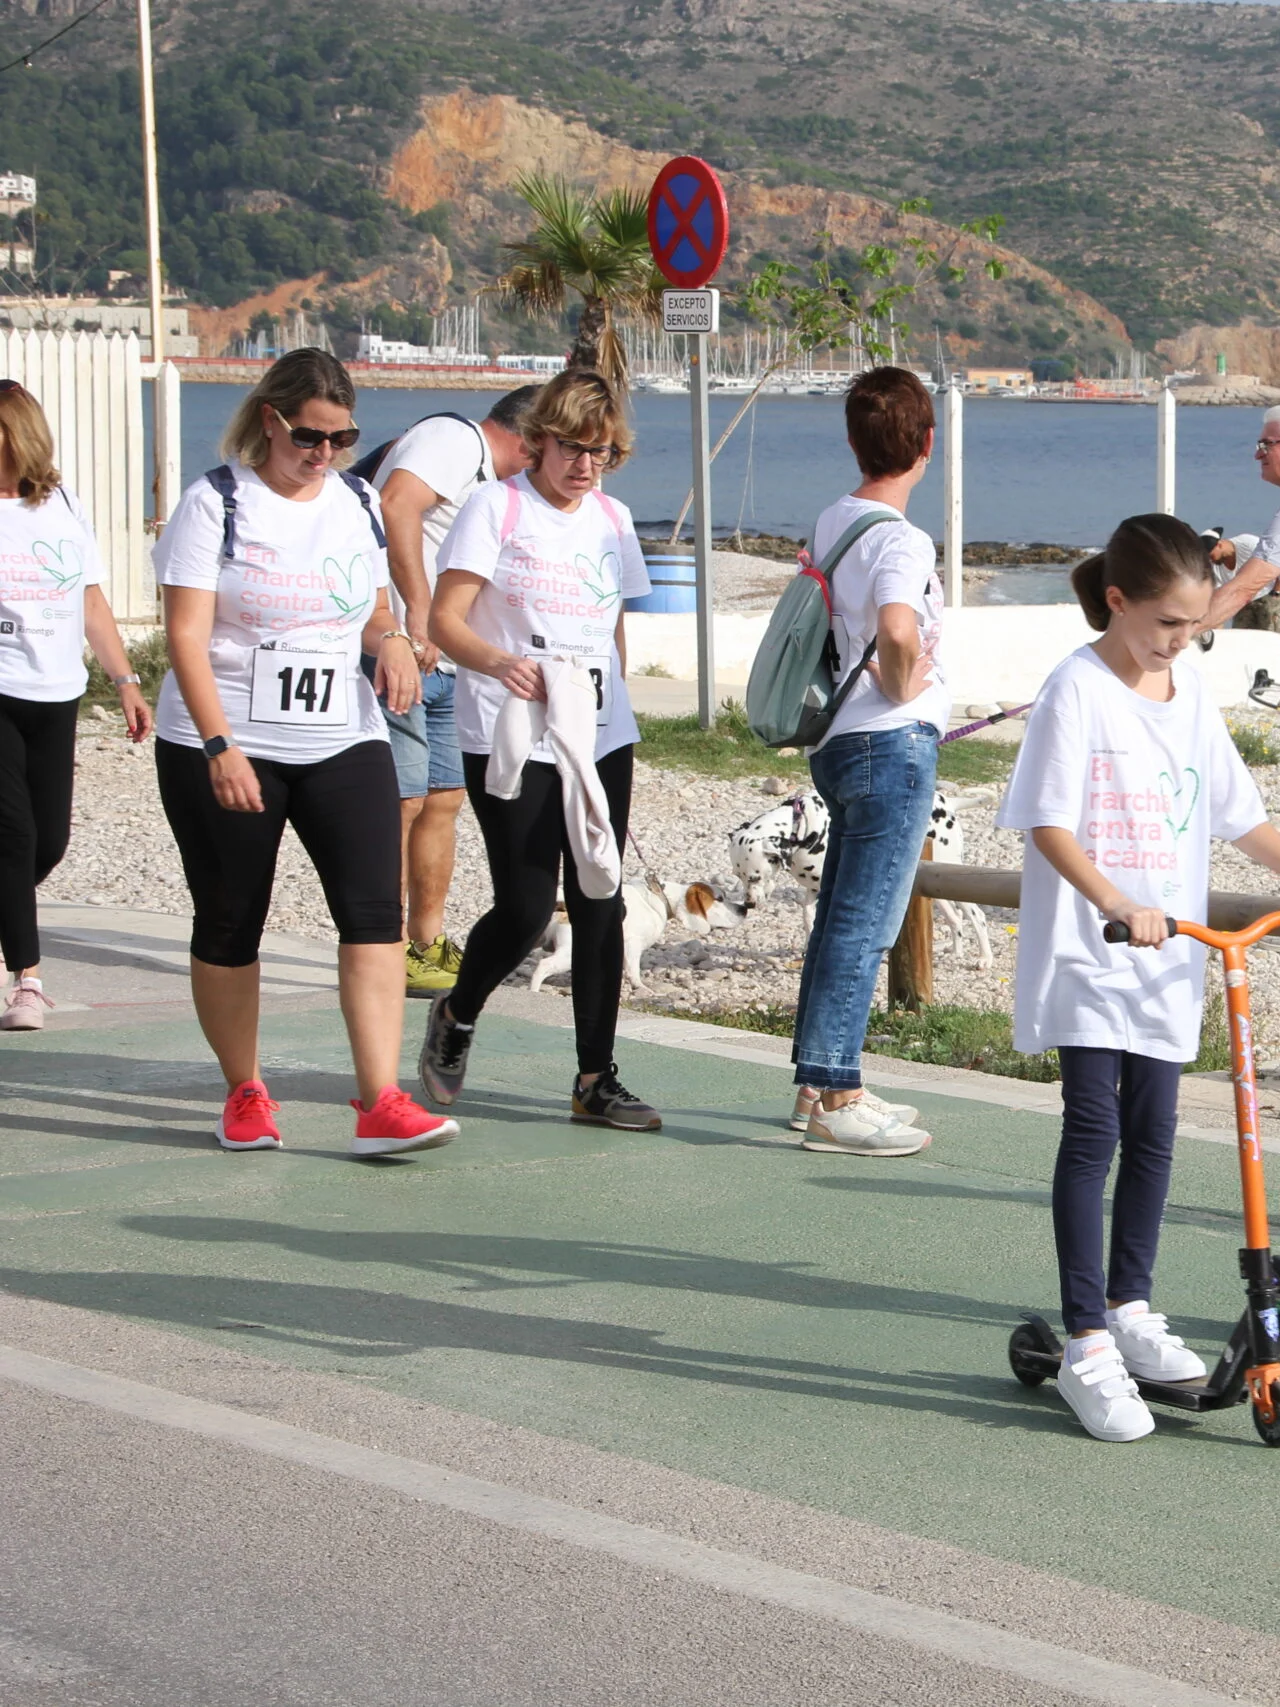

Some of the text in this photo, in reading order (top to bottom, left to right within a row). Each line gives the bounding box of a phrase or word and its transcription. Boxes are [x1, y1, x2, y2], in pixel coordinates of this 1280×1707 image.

[668, 297, 706, 309] EXCEPTO
[666, 314, 709, 326] SERVICIOS
[0, 552, 48, 565] rcha
[245, 546, 276, 563] En
[0, 567, 40, 582] ntra
[511, 555, 588, 579] marcha
[244, 567, 337, 590] marcha
[507, 573, 580, 597] contra
[0, 585, 67, 601] cáncer
[241, 590, 323, 612] contra
[533, 597, 608, 620] cáncer
[550, 640, 594, 654] Rimontgo
[278, 666, 335, 713] 147
